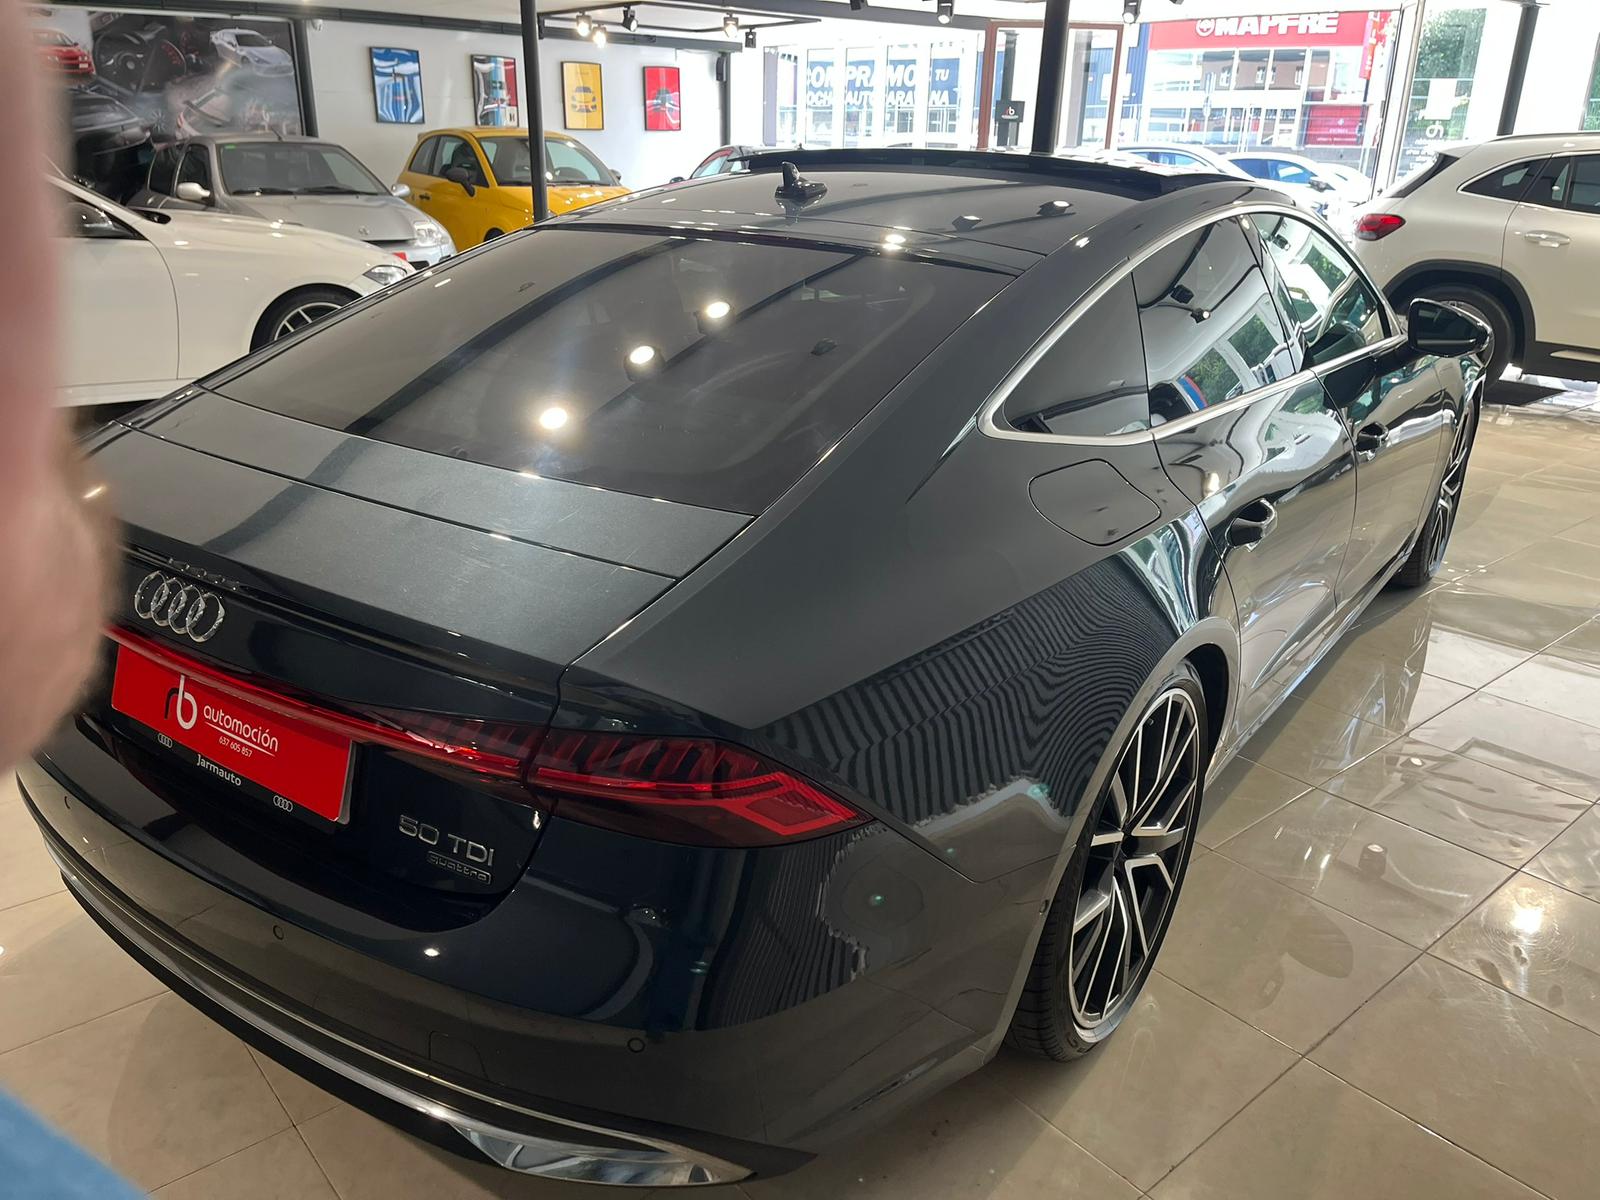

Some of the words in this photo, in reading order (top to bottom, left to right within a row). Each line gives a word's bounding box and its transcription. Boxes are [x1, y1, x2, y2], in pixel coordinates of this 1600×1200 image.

[1215, 12, 1340, 36] MAPFRE
[934, 69, 950, 81] TU
[203, 705, 278, 752] automoción
[196, 754, 242, 786] Jarmauto
[399, 814, 440, 845] 50
[447, 833, 494, 866] TDI
[428, 853, 489, 882] quattro
